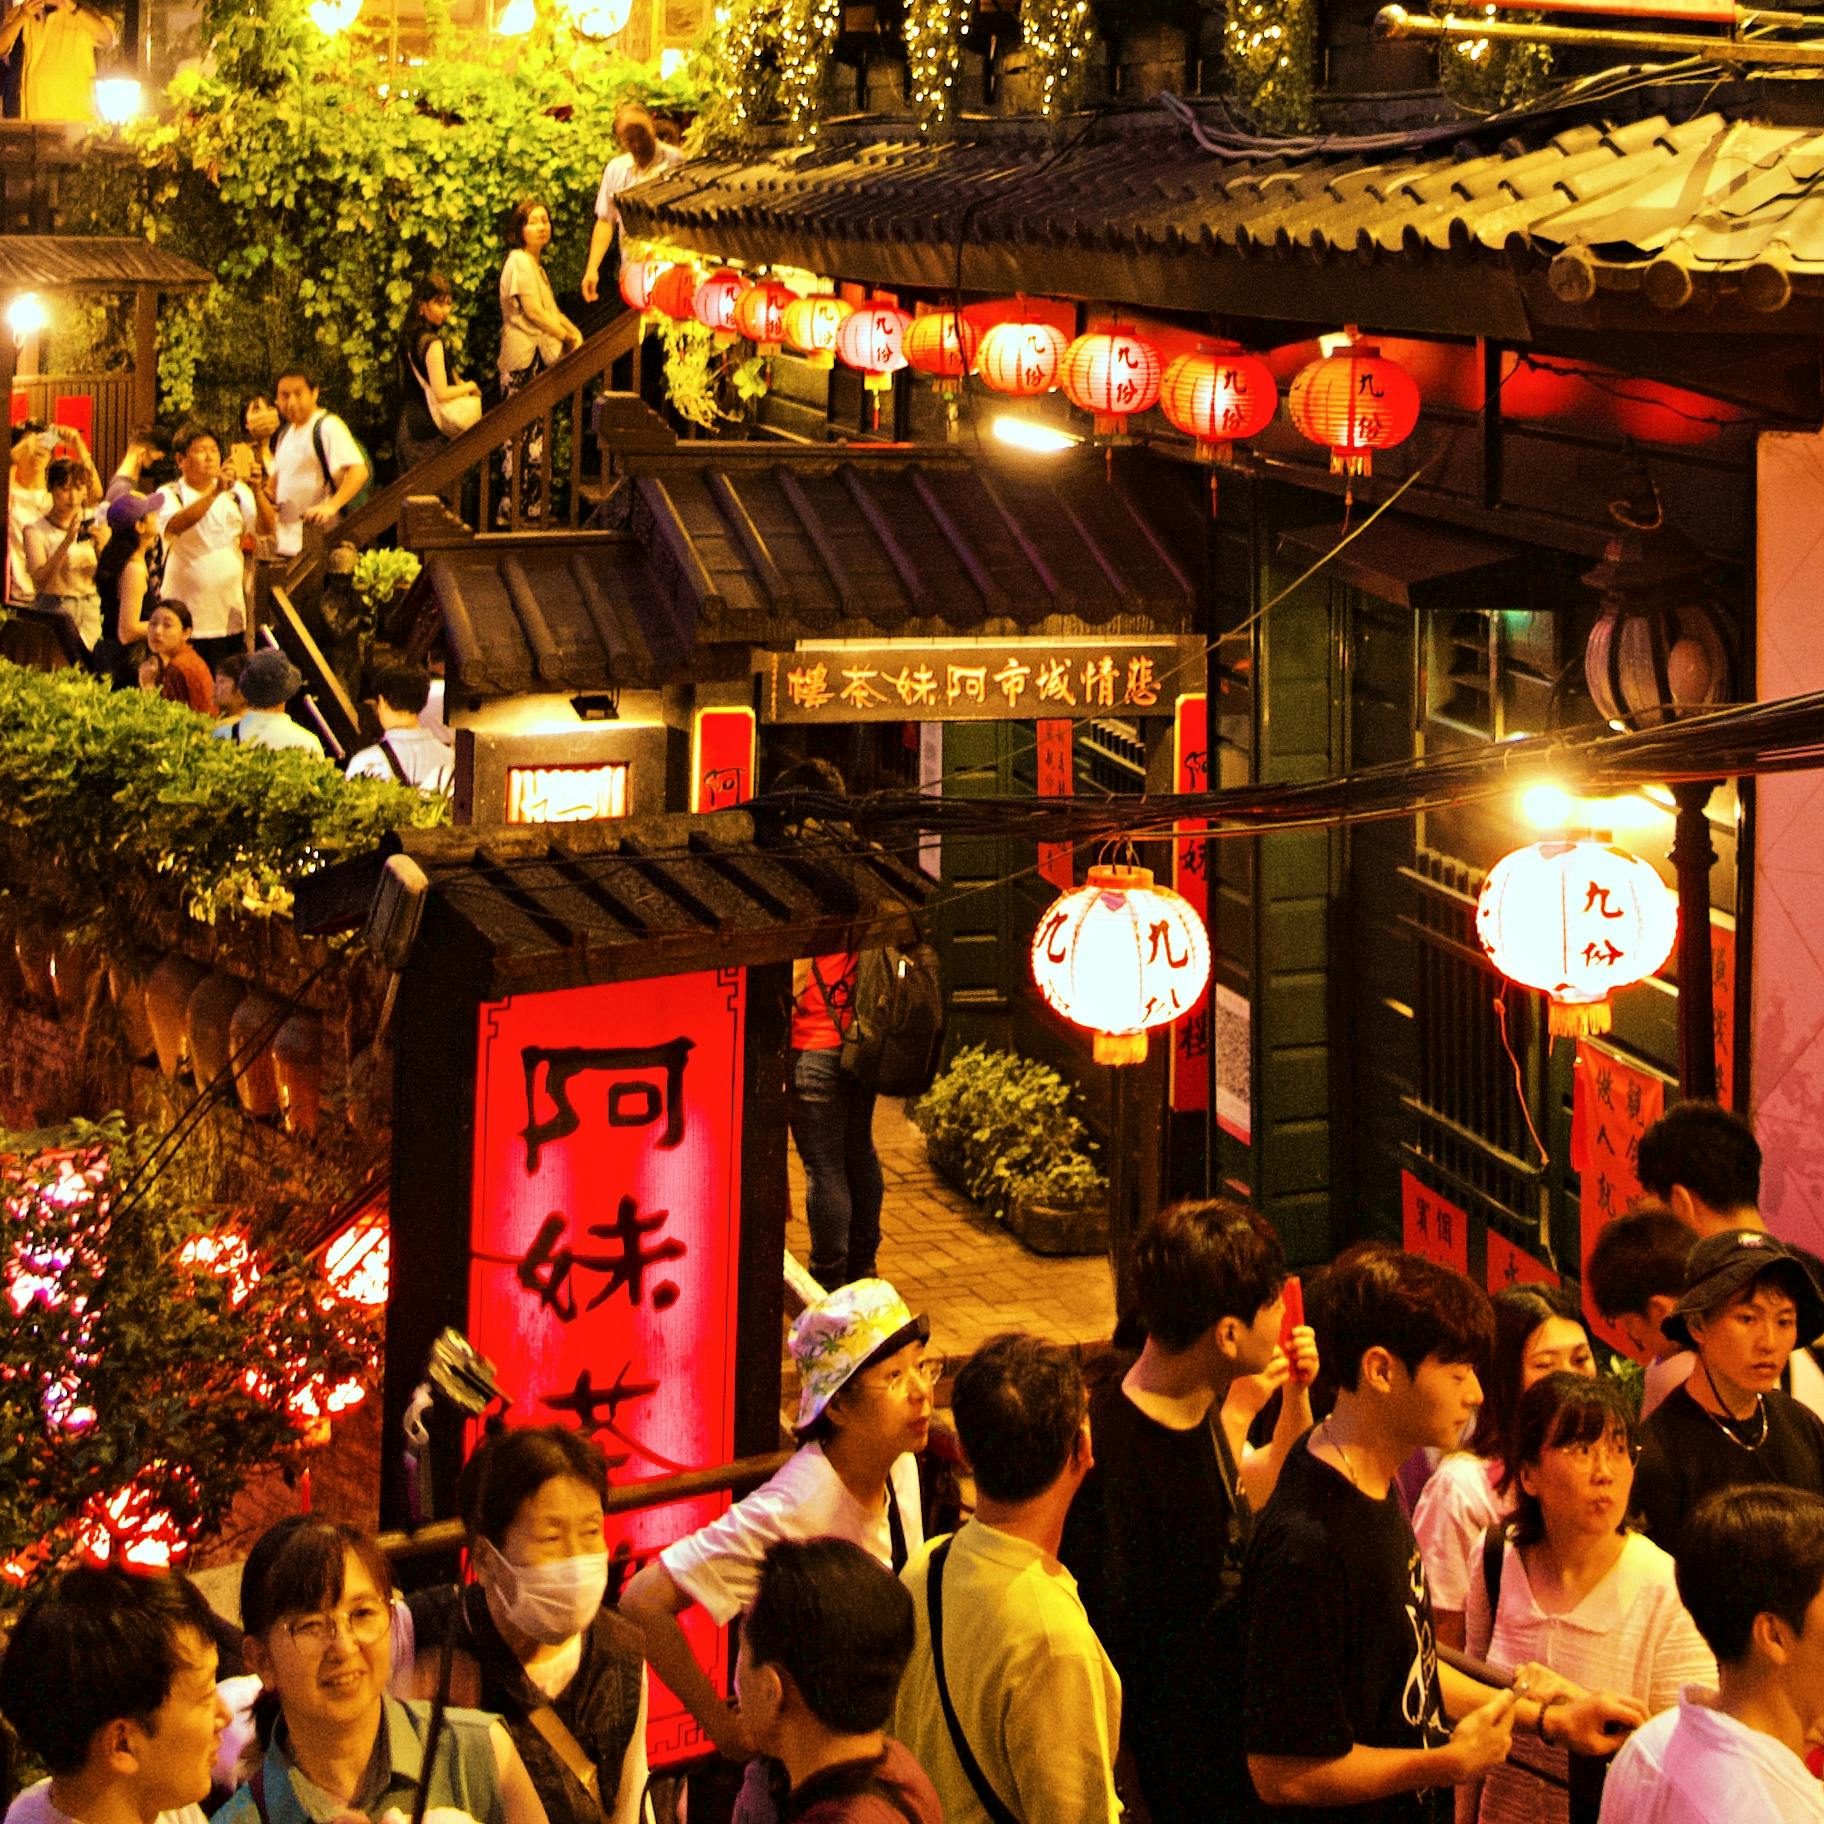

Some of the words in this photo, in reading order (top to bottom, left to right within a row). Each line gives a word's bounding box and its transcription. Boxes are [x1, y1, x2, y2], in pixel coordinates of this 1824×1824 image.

[876, 317, 894, 364] 九份
[1025, 335, 1047, 388] 九份
[1116, 346, 1139, 405] 九份
[1222, 371, 1247, 432] 九份
[1358, 374, 1384, 440] 九份
[787, 654, 1162, 709] 悲情城市阿妹茶樓
[1579, 879, 1624, 968] 九份
[516, 1037, 696, 1576] 阿妹茶
